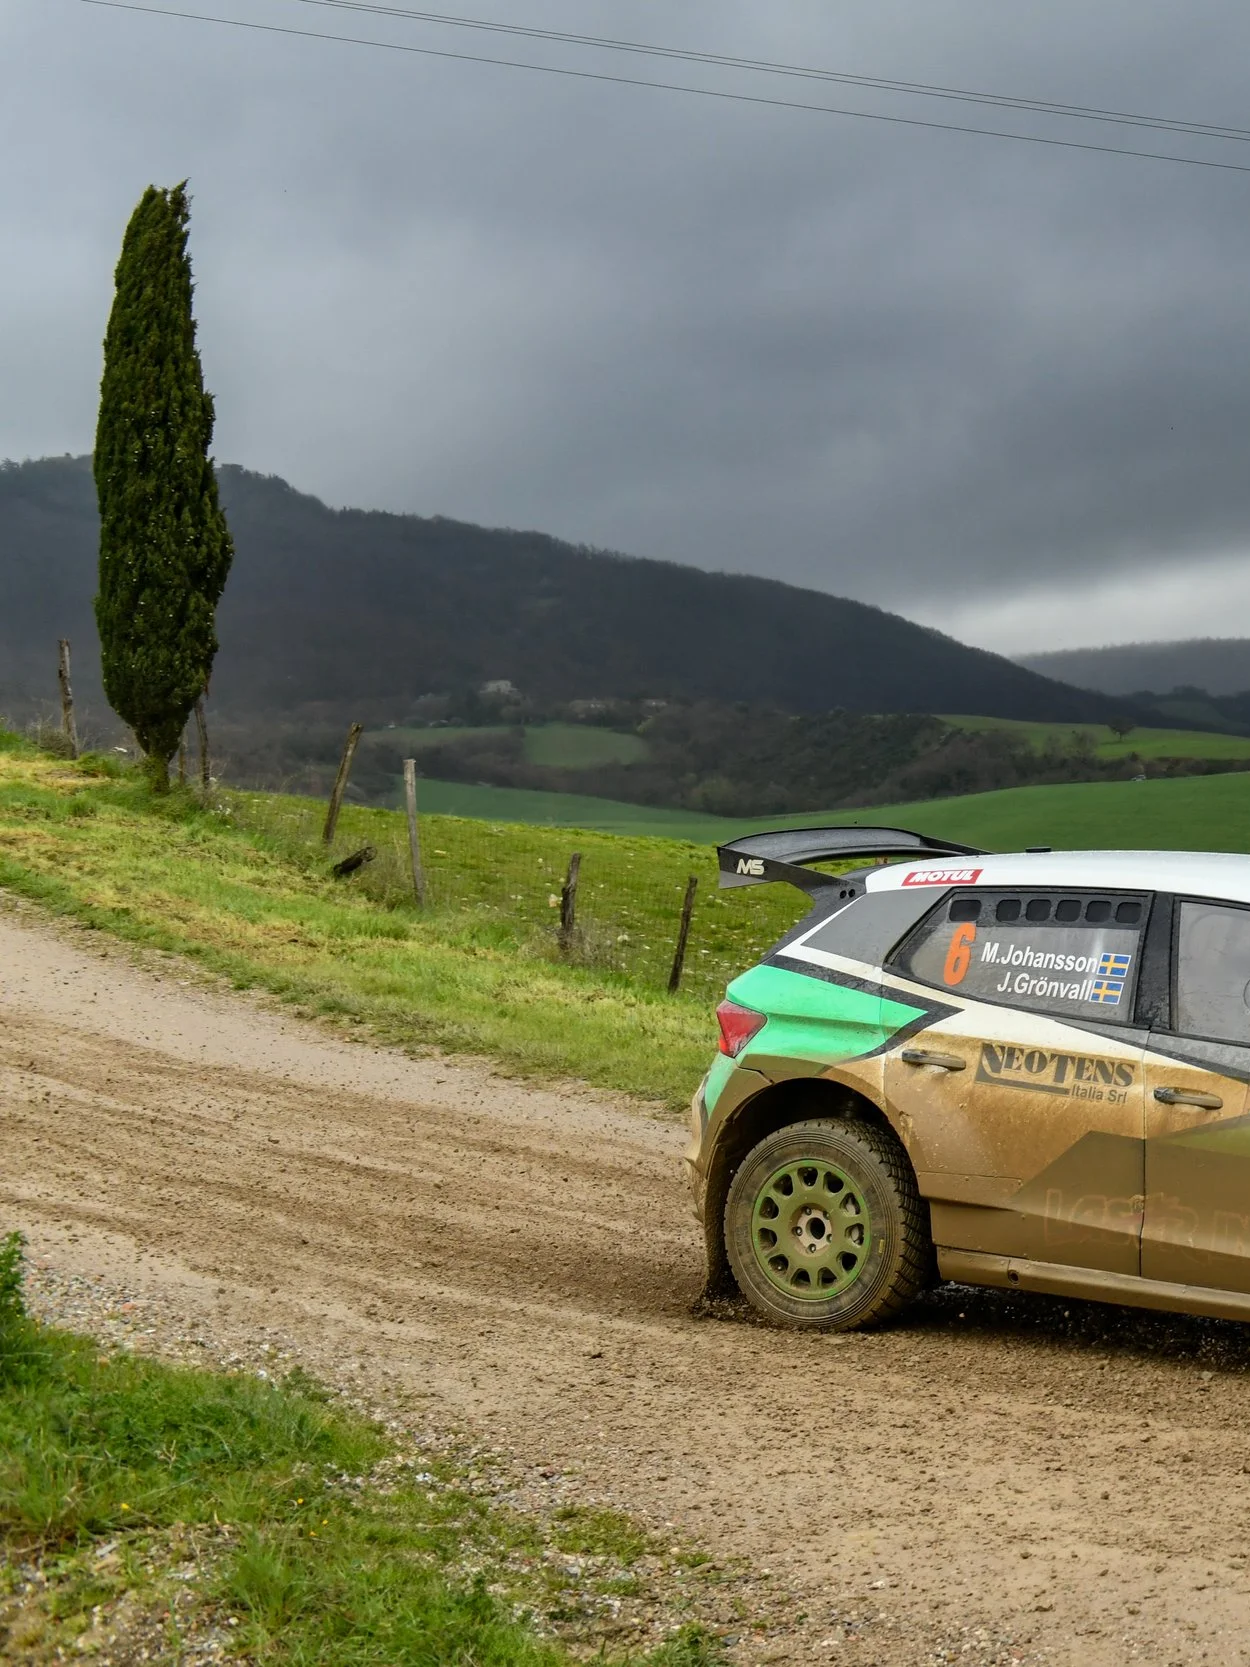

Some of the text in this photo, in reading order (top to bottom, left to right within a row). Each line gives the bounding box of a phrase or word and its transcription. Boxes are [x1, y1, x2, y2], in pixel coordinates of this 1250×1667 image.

[736, 859, 765, 876] MS
[907, 869, 974, 884] MOTUL
[943, 922, 977, 986] 6
[981, 941, 1098, 973] M.Johansson
[997, 973, 1093, 1001] J.Grönvall
[976, 1042, 1137, 1090] NEOTENS
[1071, 1084, 1128, 1105] Italia Srl
